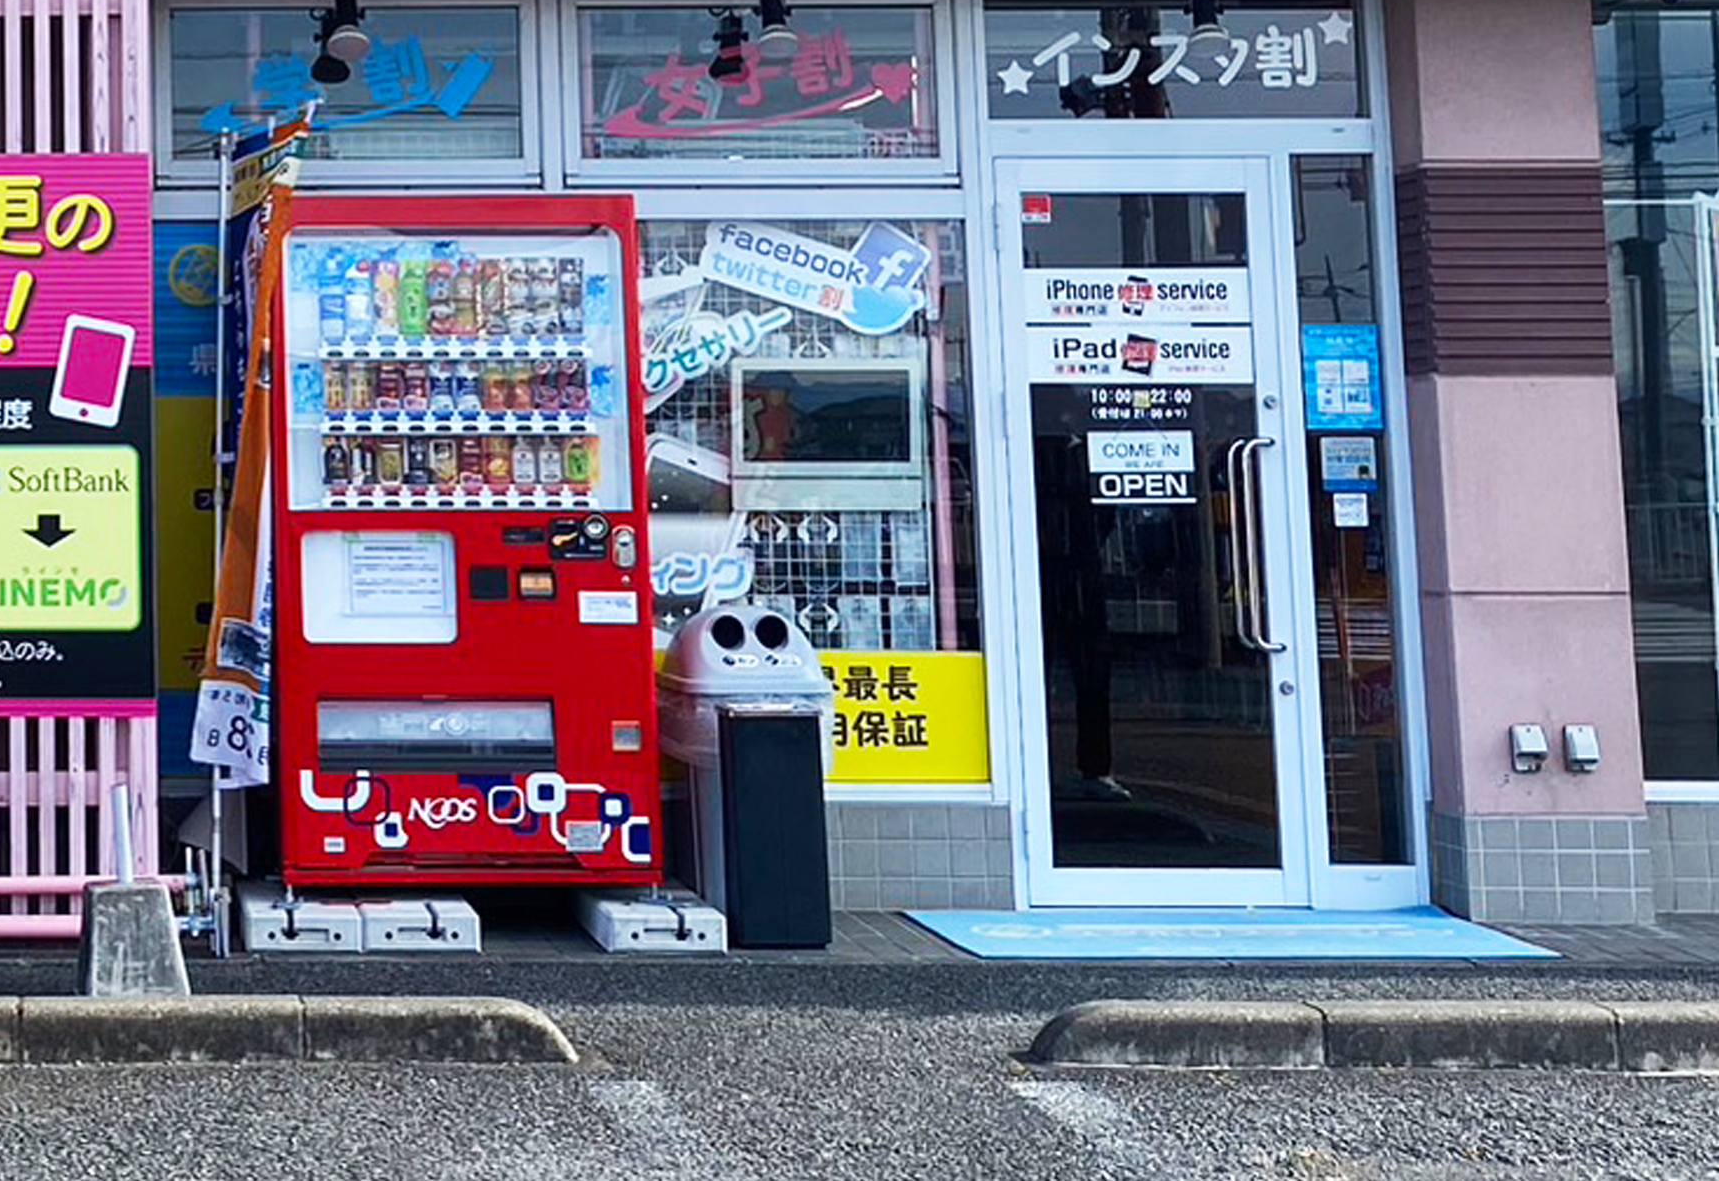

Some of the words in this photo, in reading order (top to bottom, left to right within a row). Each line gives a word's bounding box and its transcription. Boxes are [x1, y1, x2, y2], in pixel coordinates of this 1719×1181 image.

[718, 223, 865, 287] facebook
[1046, 278, 1114, 300] iPhone
[1157, 278, 1227, 300] service
[1052, 337, 1117, 359] iPad
[1160, 336, 1230, 359] service
[1102, 443, 1156, 458] COME
[1162, 443, 1181, 458] IN
[8, 466, 131, 492] SoftBank
[1099, 474, 1188, 497] OPEN
